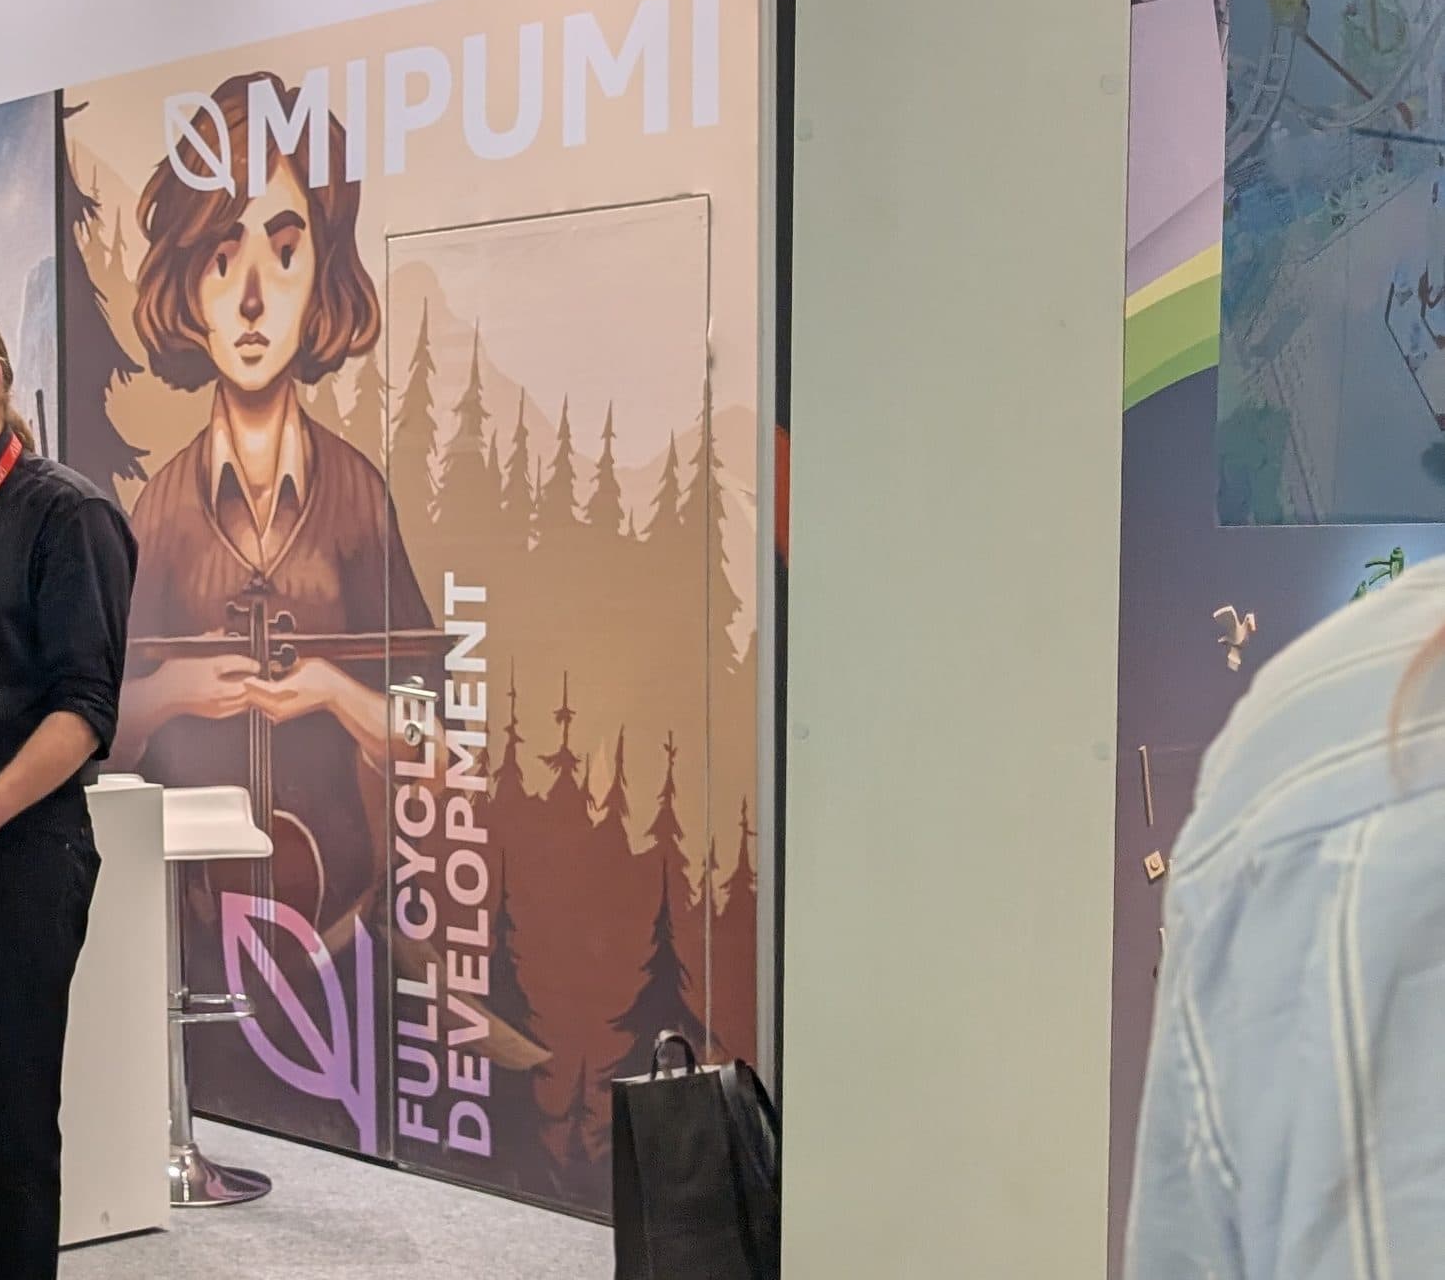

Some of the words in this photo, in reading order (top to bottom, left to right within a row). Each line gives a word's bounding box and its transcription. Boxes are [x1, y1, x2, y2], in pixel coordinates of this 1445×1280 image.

[395, 692, 438, 940] CYCLE
[445, 571, 493, 1157] DEVELOPMENT
[397, 963, 439, 1145] FULL
